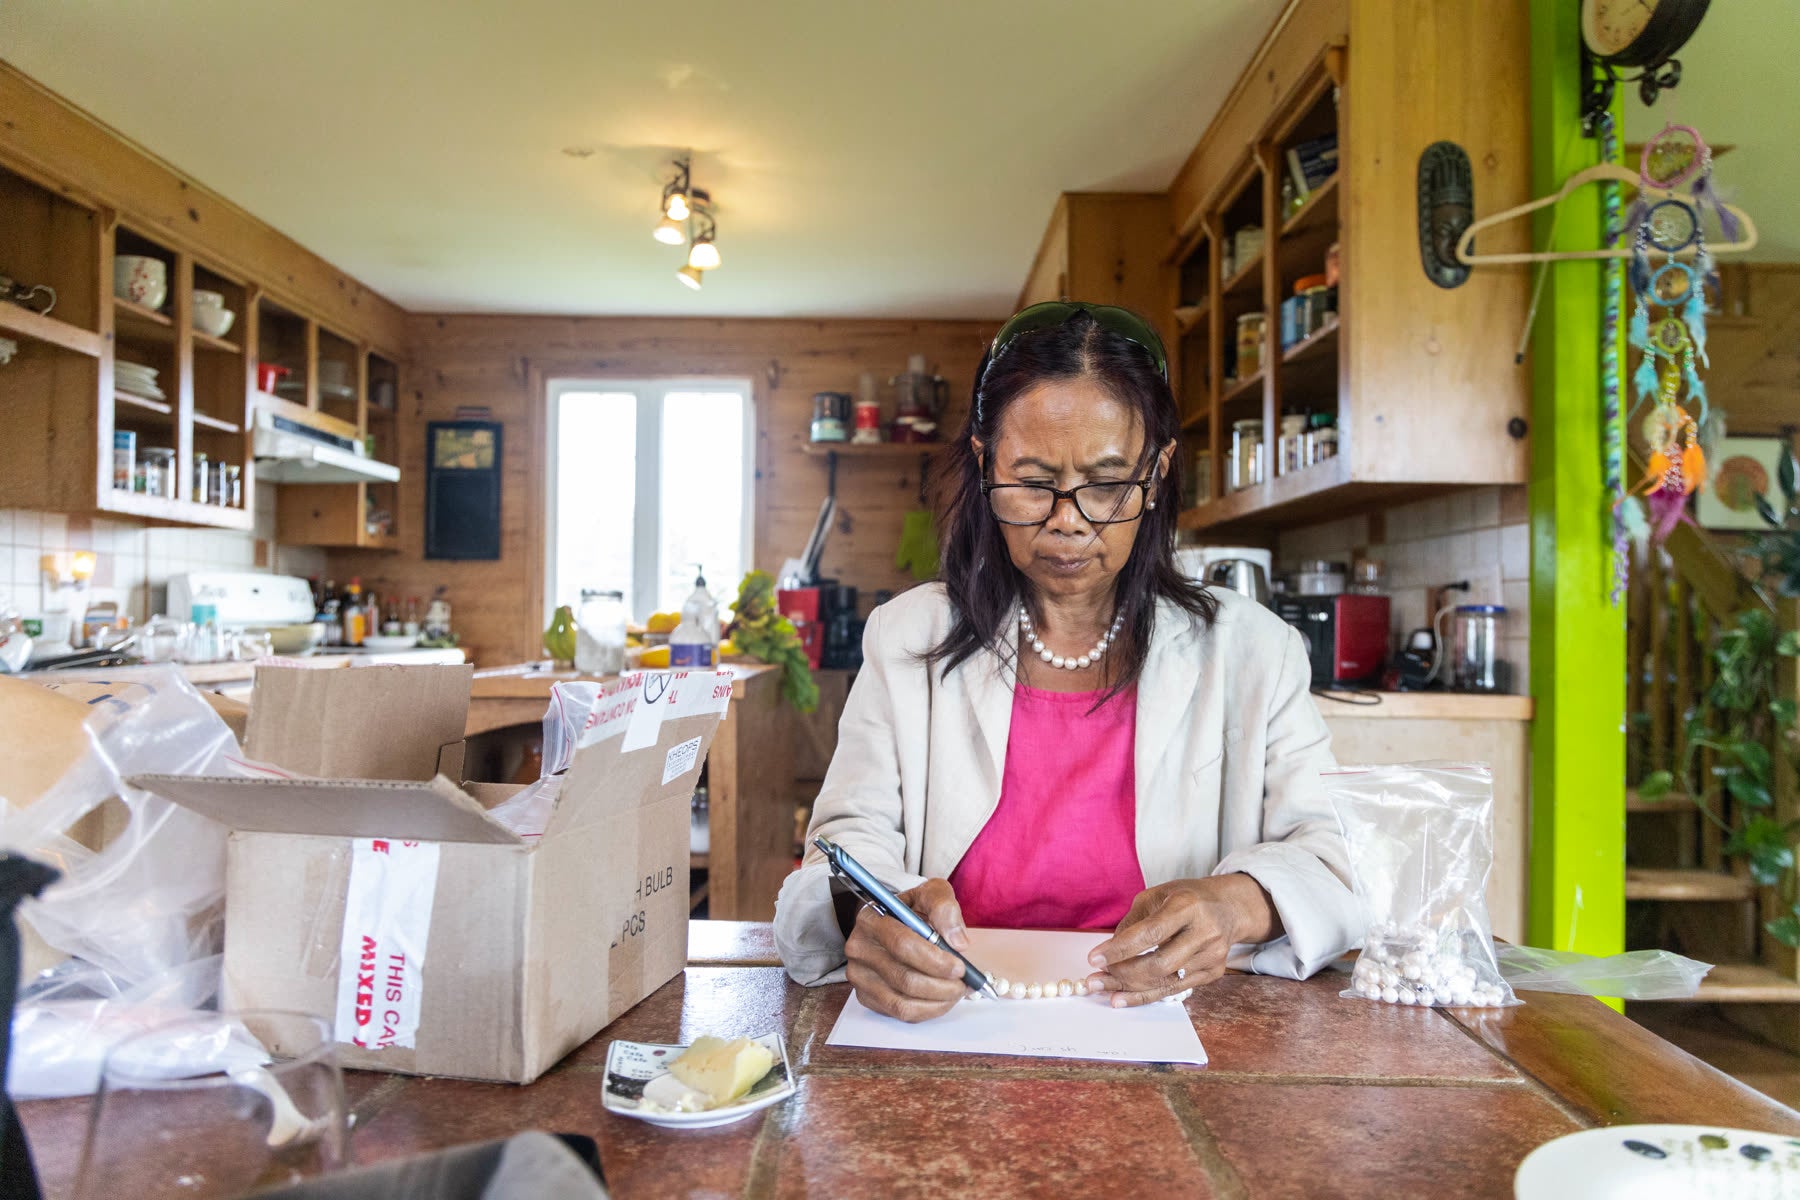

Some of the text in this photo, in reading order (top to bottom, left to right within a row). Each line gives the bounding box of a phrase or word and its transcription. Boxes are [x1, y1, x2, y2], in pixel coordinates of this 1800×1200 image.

[645, 866, 673, 897] BULB
[622, 910, 646, 942] PCS
[355, 935, 377, 1027] MIXED
[386, 952, 406, 1003] THIS
